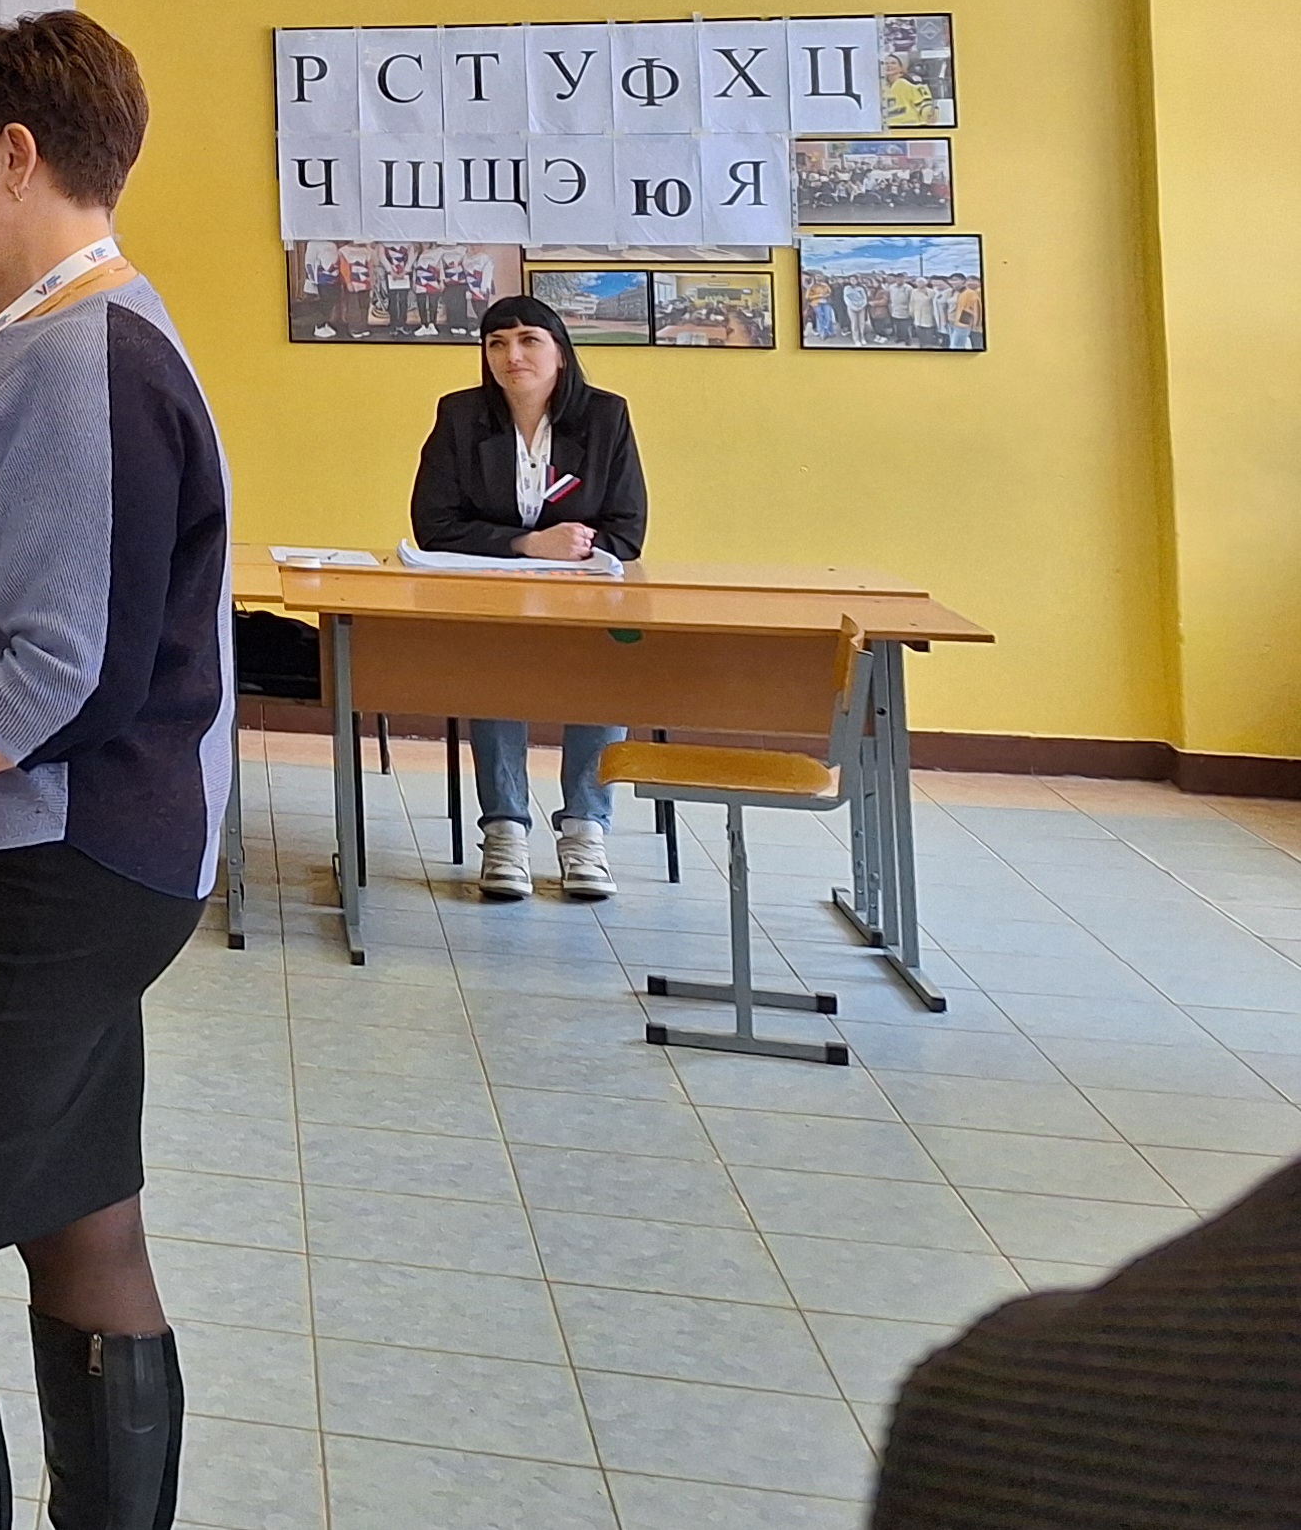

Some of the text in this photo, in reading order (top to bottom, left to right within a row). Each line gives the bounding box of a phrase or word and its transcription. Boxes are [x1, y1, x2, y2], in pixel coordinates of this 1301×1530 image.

[289, 45, 863, 110] Р С Т У Ф Х Ц
[291, 157, 341, 207] Ч
[378, 159, 444, 211] Ш
[457, 157, 529, 216] Щ
[543, 157, 588, 206] Э
[719, 159, 768, 207] Я
